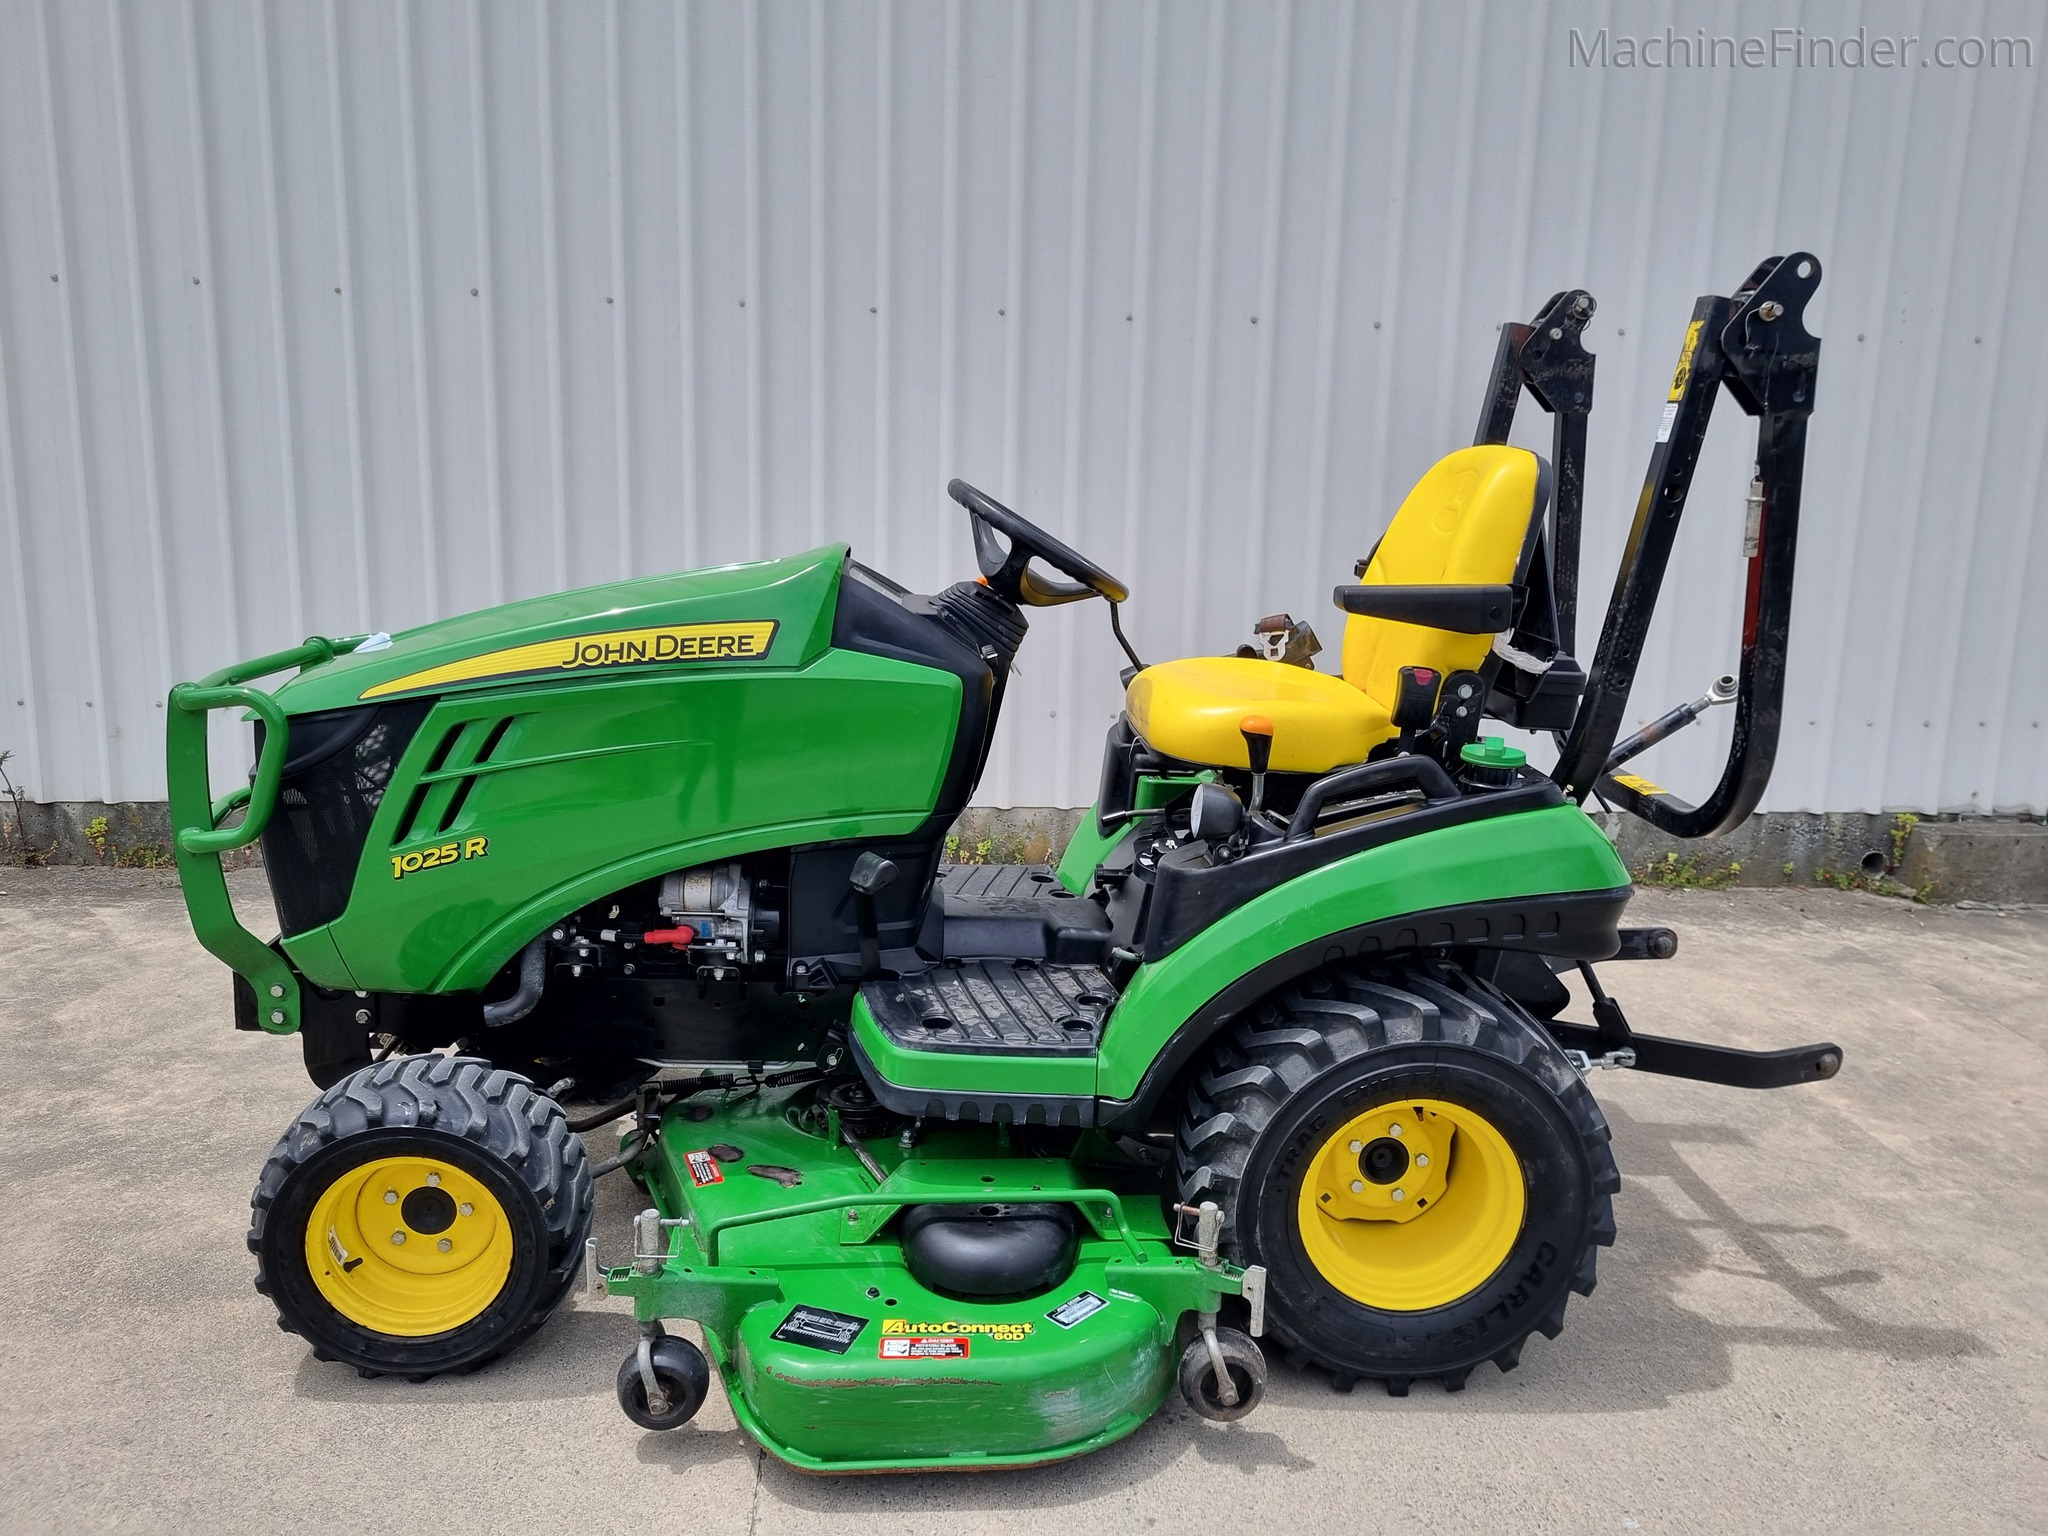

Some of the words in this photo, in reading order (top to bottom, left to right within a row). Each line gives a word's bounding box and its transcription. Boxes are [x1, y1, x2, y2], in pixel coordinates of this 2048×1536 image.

[562, 640, 647, 666] JOHN
[655, 635, 755, 658] DEERE
[391, 842, 460, 879] 1025
[465, 837, 488, 860] R
[884, 1319, 1033, 1334] AutoConnect
[993, 1332, 1026, 1341] 60D
